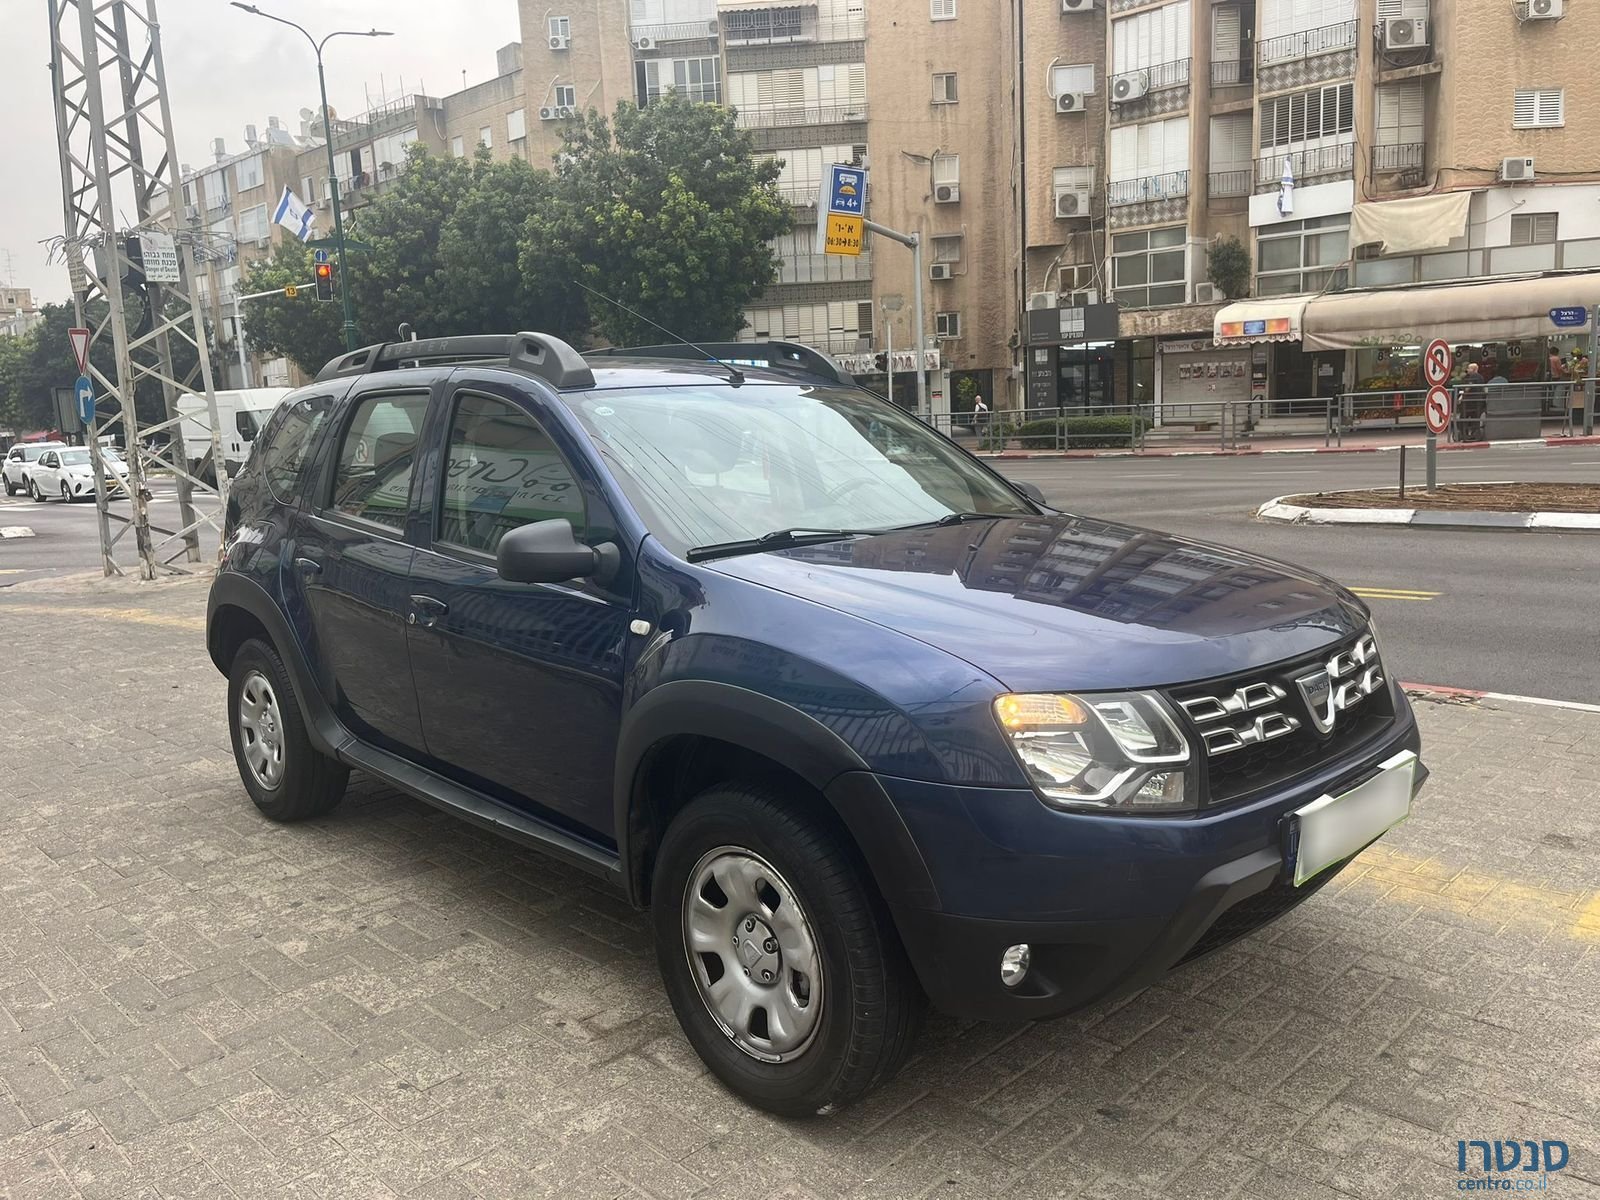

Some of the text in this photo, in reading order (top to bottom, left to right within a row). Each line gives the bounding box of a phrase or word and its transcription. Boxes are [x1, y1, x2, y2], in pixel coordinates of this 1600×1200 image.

[846, 198, 858, 208] 4+
[286, 287, 296, 296] 13
[1507, 346, 1521, 356] 10
